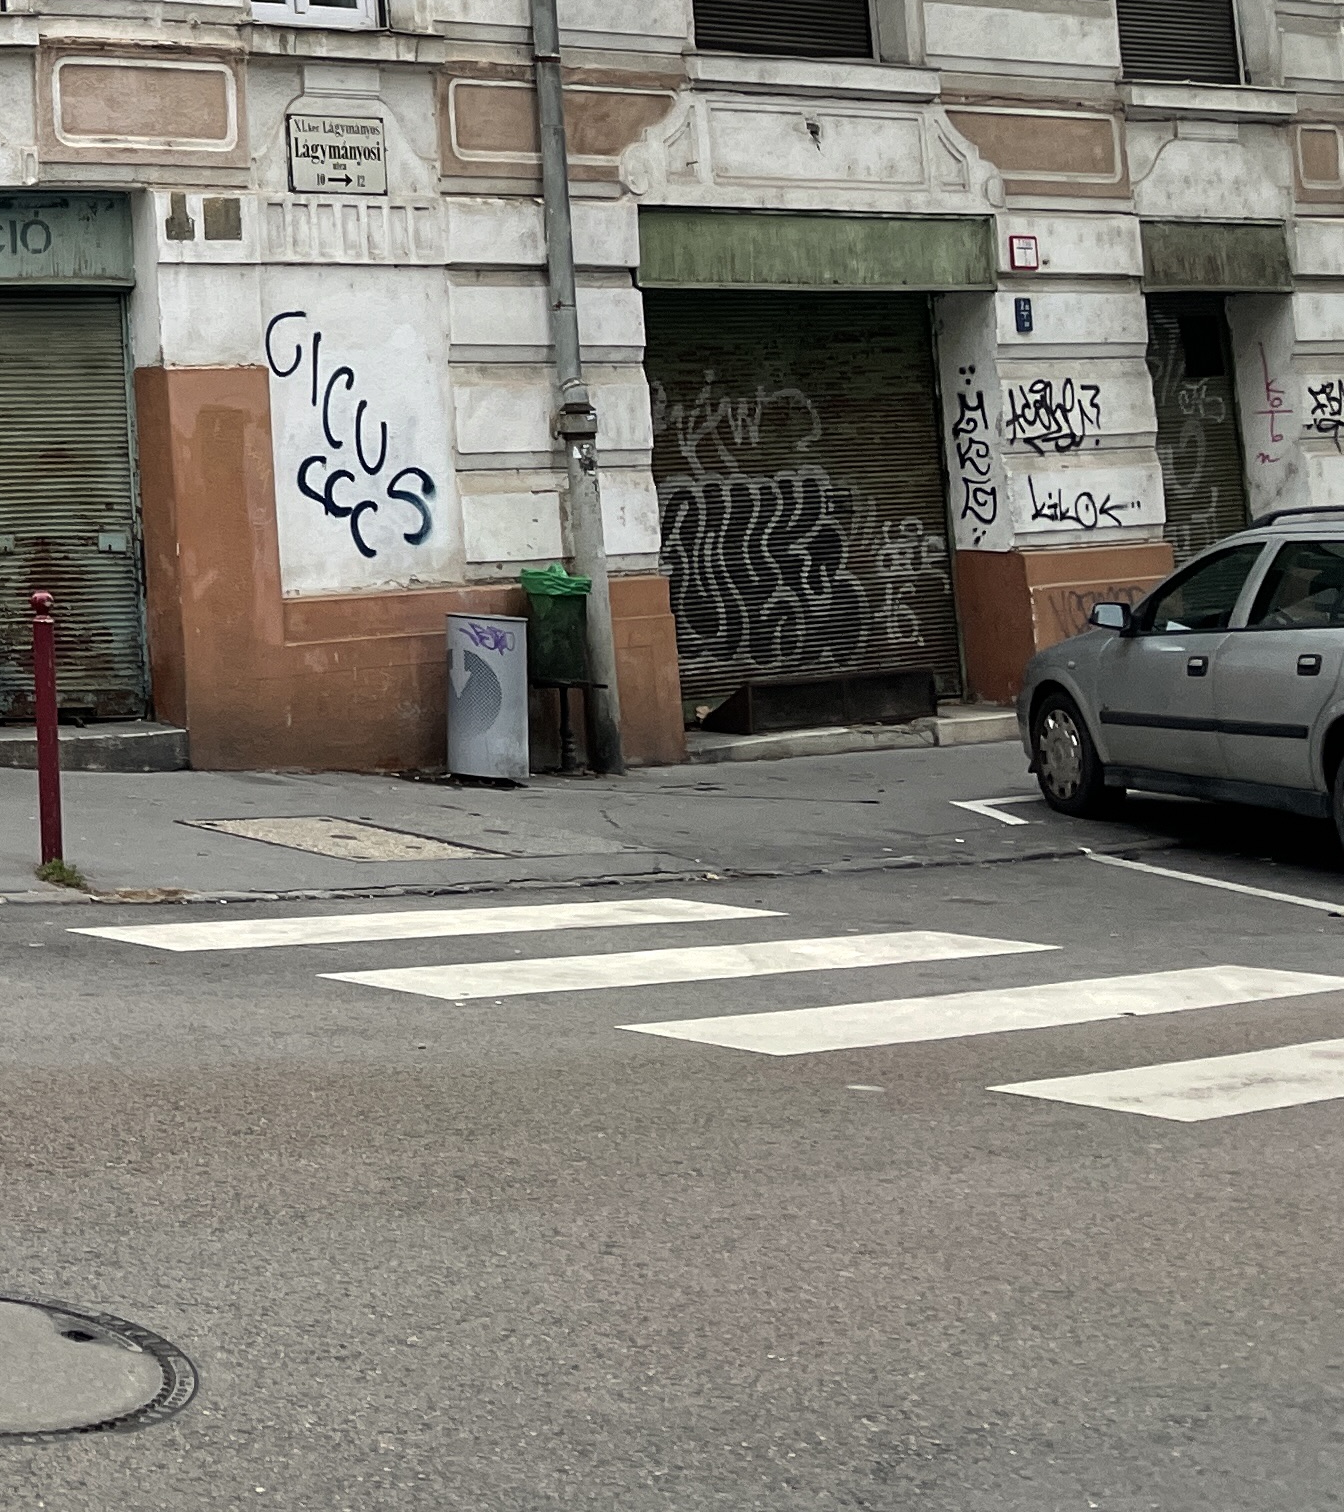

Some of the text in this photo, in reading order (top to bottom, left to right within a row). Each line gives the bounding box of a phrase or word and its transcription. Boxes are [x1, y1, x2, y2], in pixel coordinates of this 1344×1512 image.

[323, 121, 381, 139] Lágymányos
[294, 137, 381, 166] Lágymányosi
[317, 173, 365, 187] 10 12
